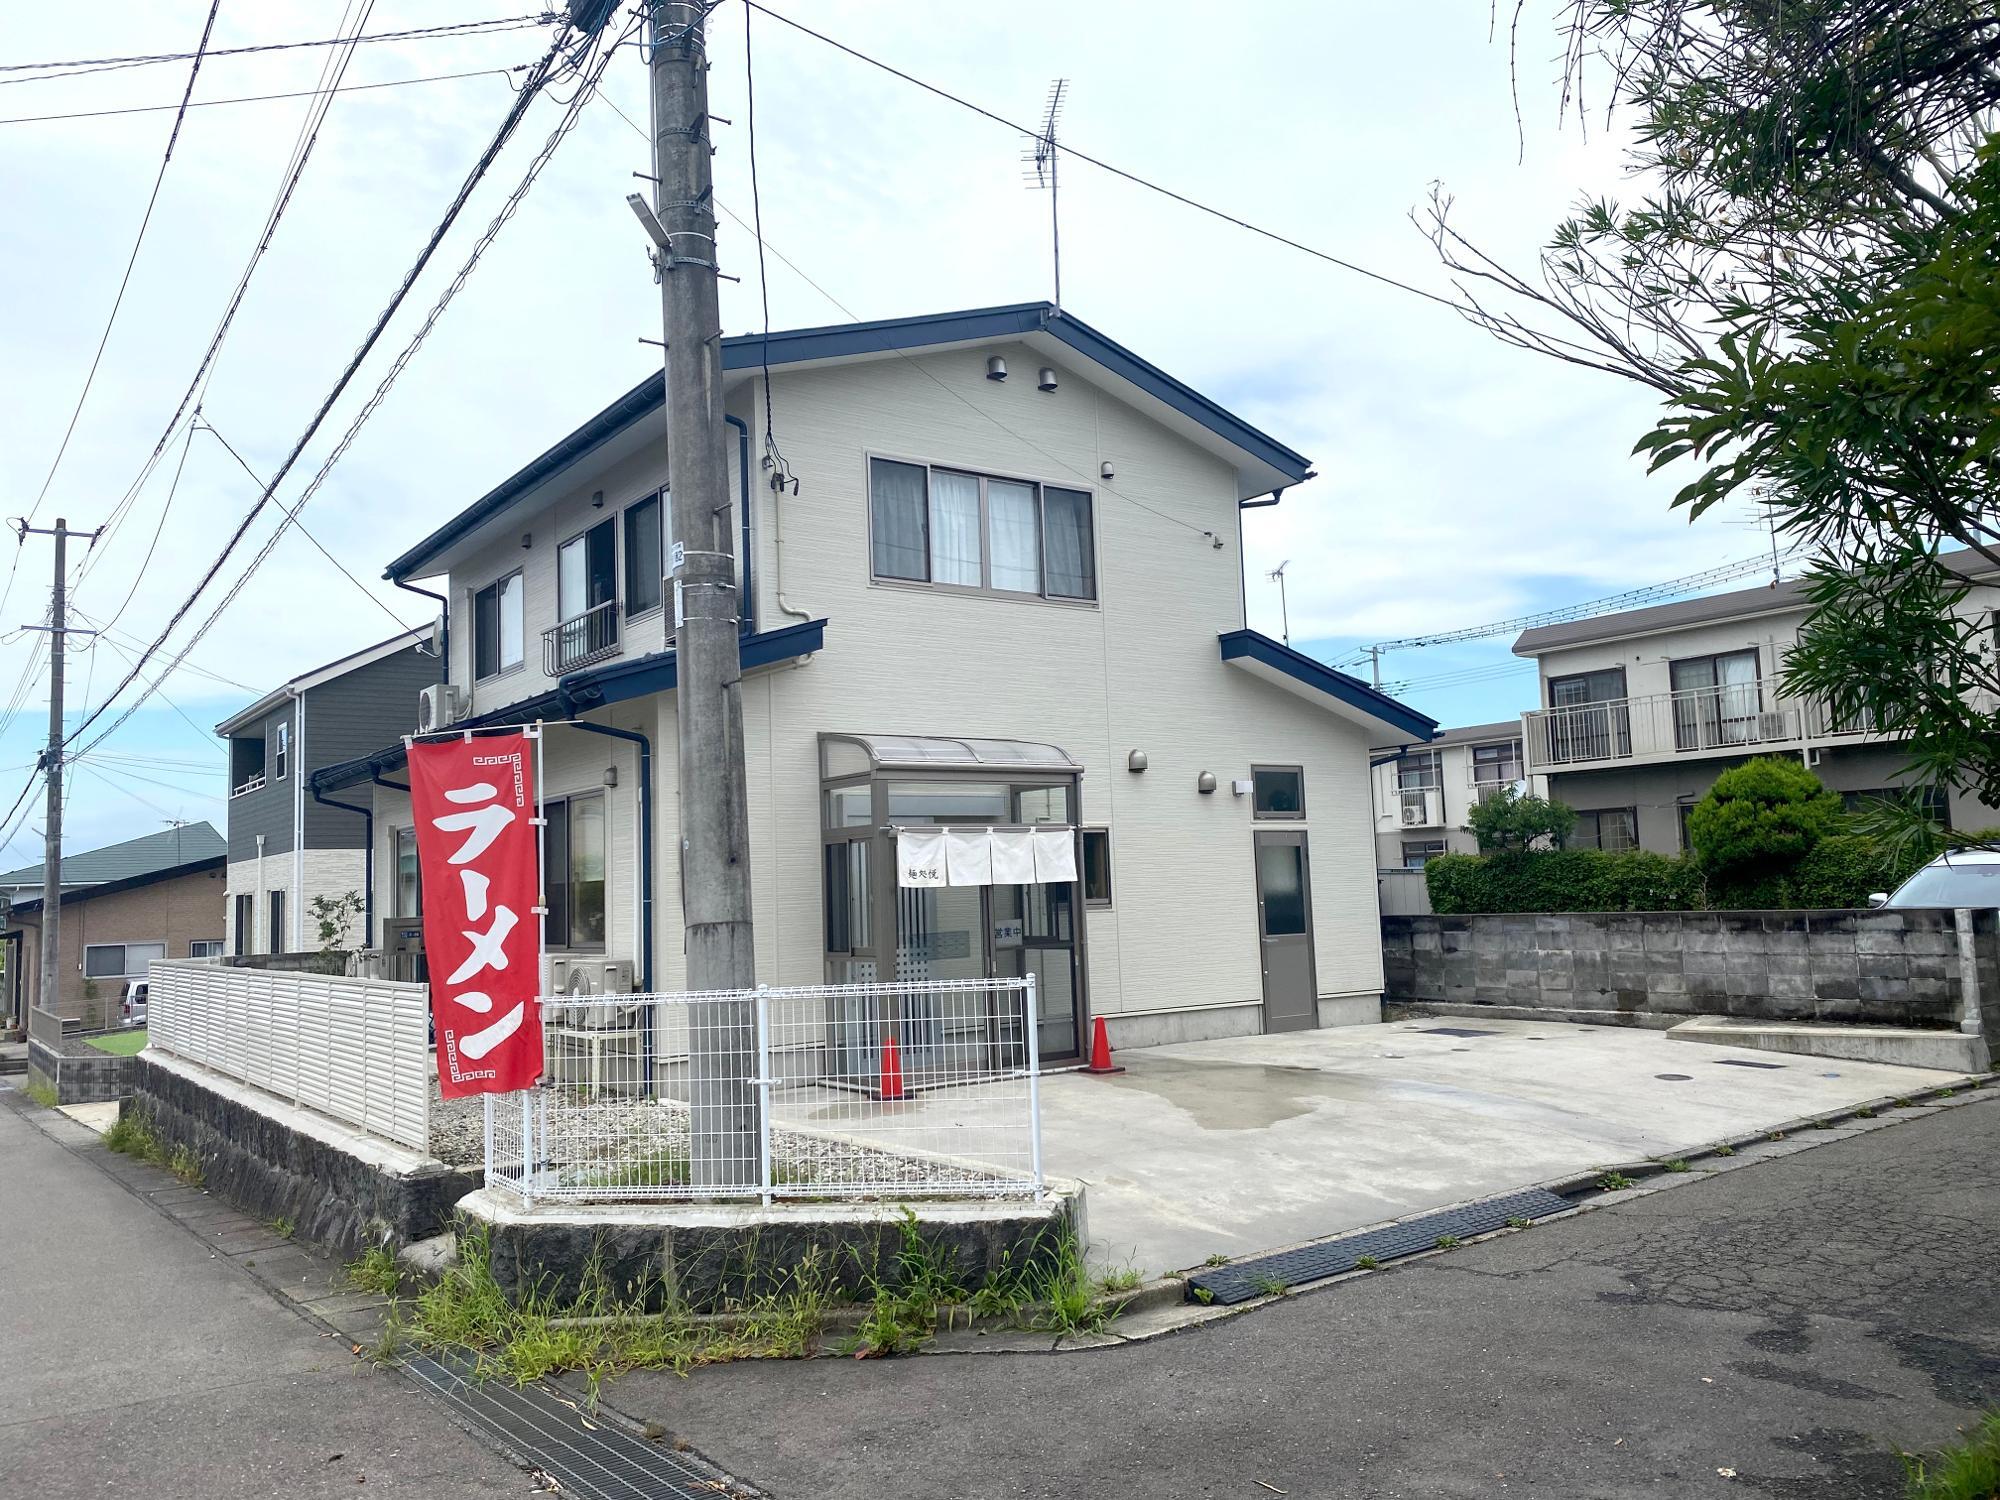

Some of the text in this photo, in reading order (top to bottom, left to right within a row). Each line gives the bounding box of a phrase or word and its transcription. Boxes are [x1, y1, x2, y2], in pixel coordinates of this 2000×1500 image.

[432, 782, 525, 1060] ラーメン
[994, 926, 1022, 939] 営業中
